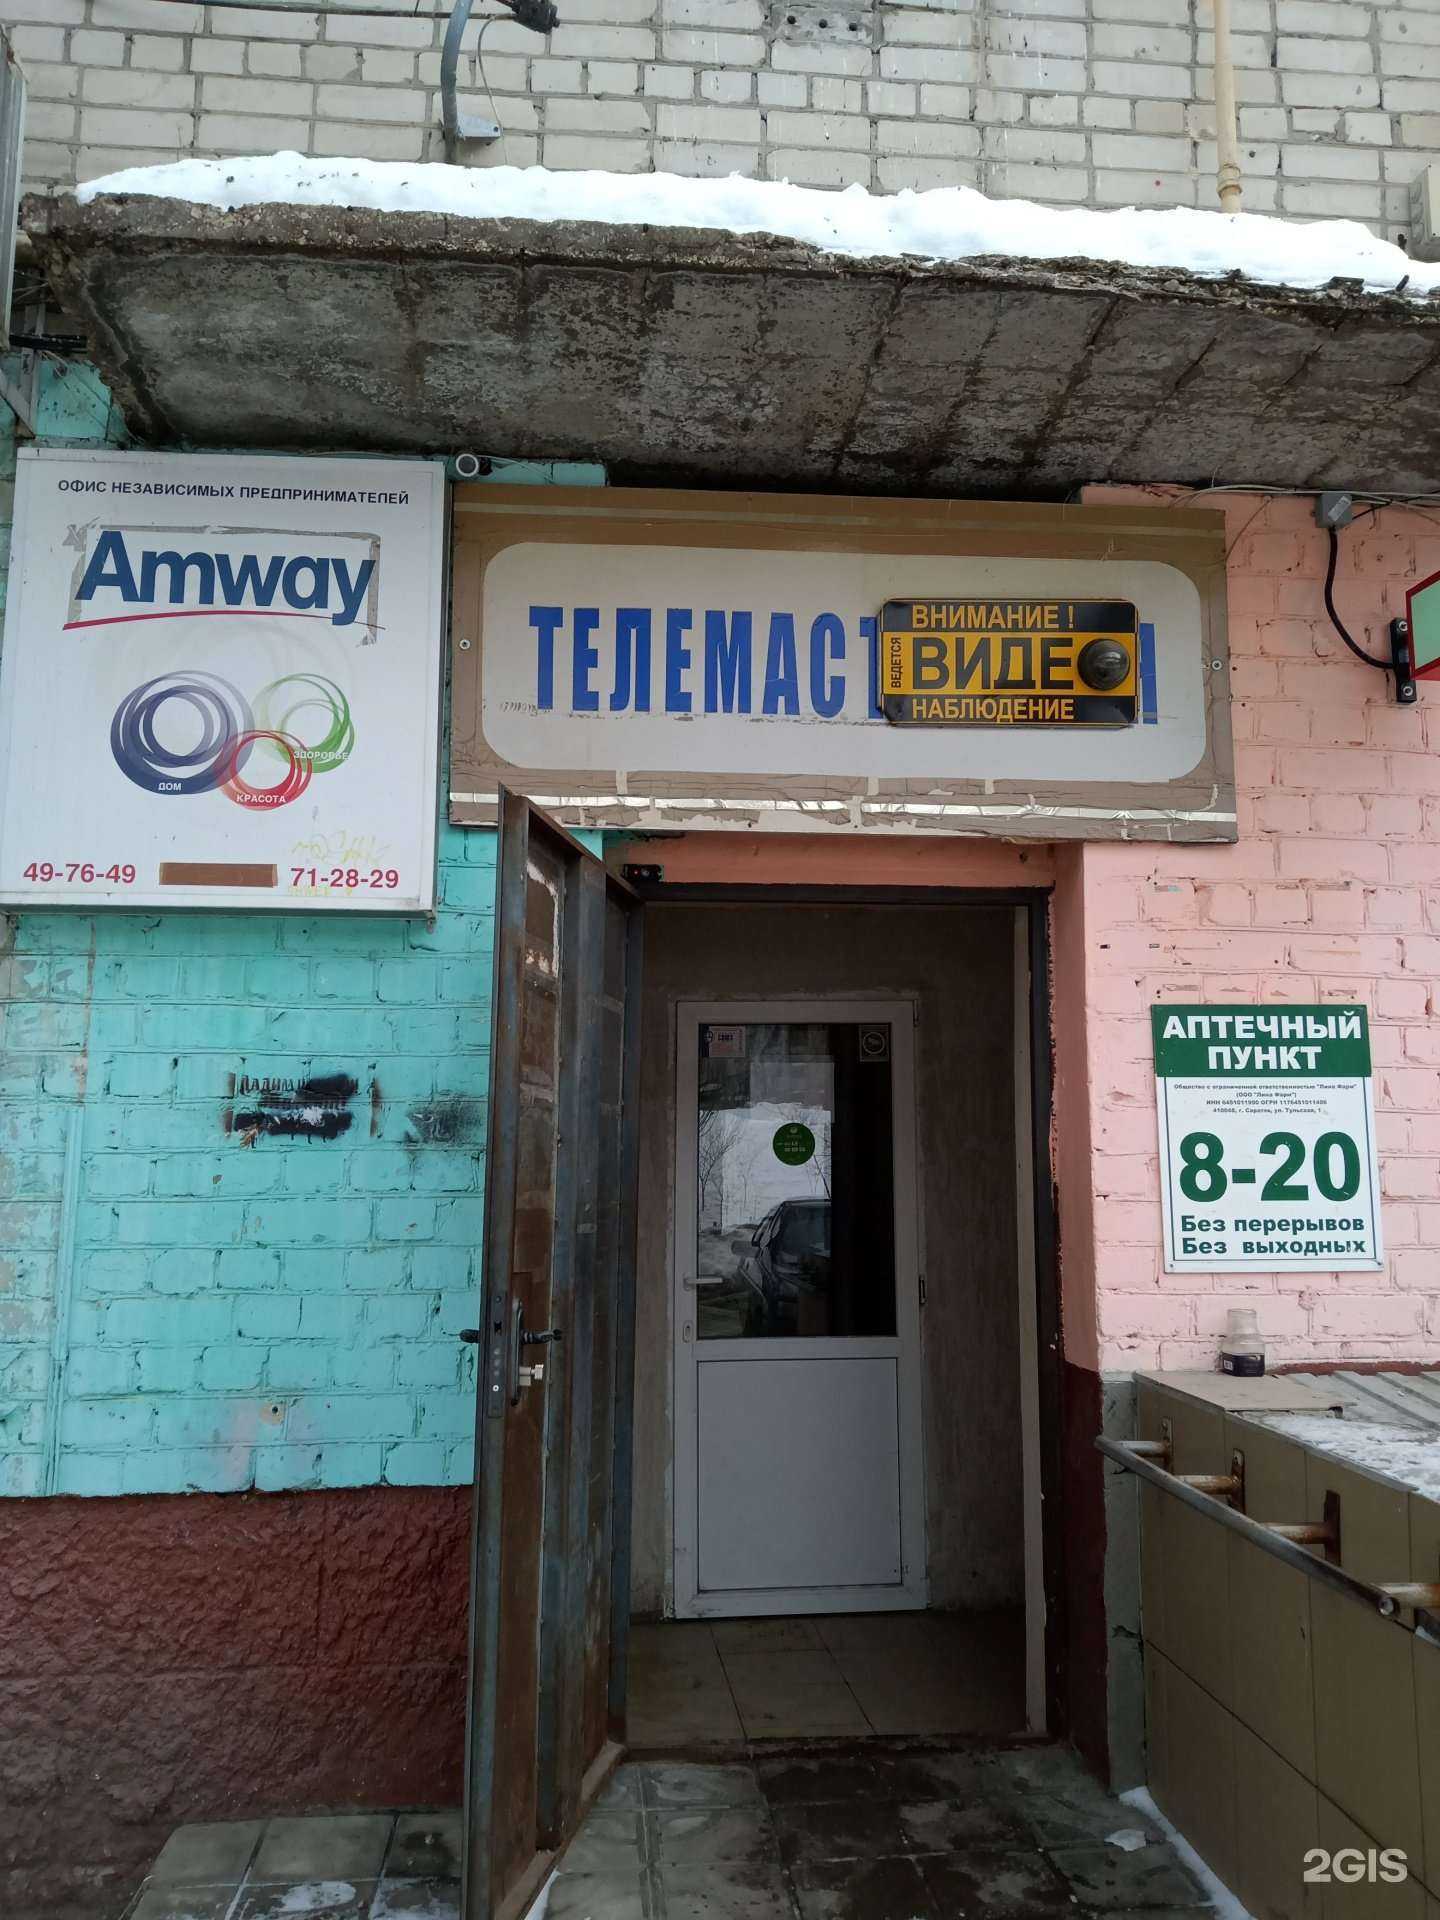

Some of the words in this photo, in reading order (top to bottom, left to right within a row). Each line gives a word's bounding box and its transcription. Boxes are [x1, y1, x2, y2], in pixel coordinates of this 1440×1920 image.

[58, 480, 107, 493] ОФИС
[111, 482, 235, 498] НЕЗАВИСИМЫХ
[240, 486, 409, 505] ПРЕДПРИНИМАТЕЛЕЙ
[75, 530, 377, 626] Amway
[912, 604, 1060, 629] ВНИМАНИЕ
[891, 637, 902, 689] ВЕДЕТСЯ
[912, 637, 1131, 691] ВИДЕ
[912, 698, 1074, 723] НАБЛЮДЕНИЕ
[293, 750, 350, 761] ЗДОРОВЬЕ
[158, 782, 182, 791] ДОМ
[236, 794, 286, 804] КРАСОТА
[23, 862, 136, 884] 49-76-49
[290, 867, 399, 889] 71-28-29
[1163, 1010, 1362, 1040] АПТЕЧНЫЙ
[1207, 1045, 1322, 1070] ПУНКТ
[1179, 1131, 1361, 1203] 8-20
[1181, 1214, 1226, 1233] Без
[1234, 1217, 1365, 1236] перерывов
[1182, 1237, 1228, 1255] Без
[1242, 1239, 1367, 1257] выходных
